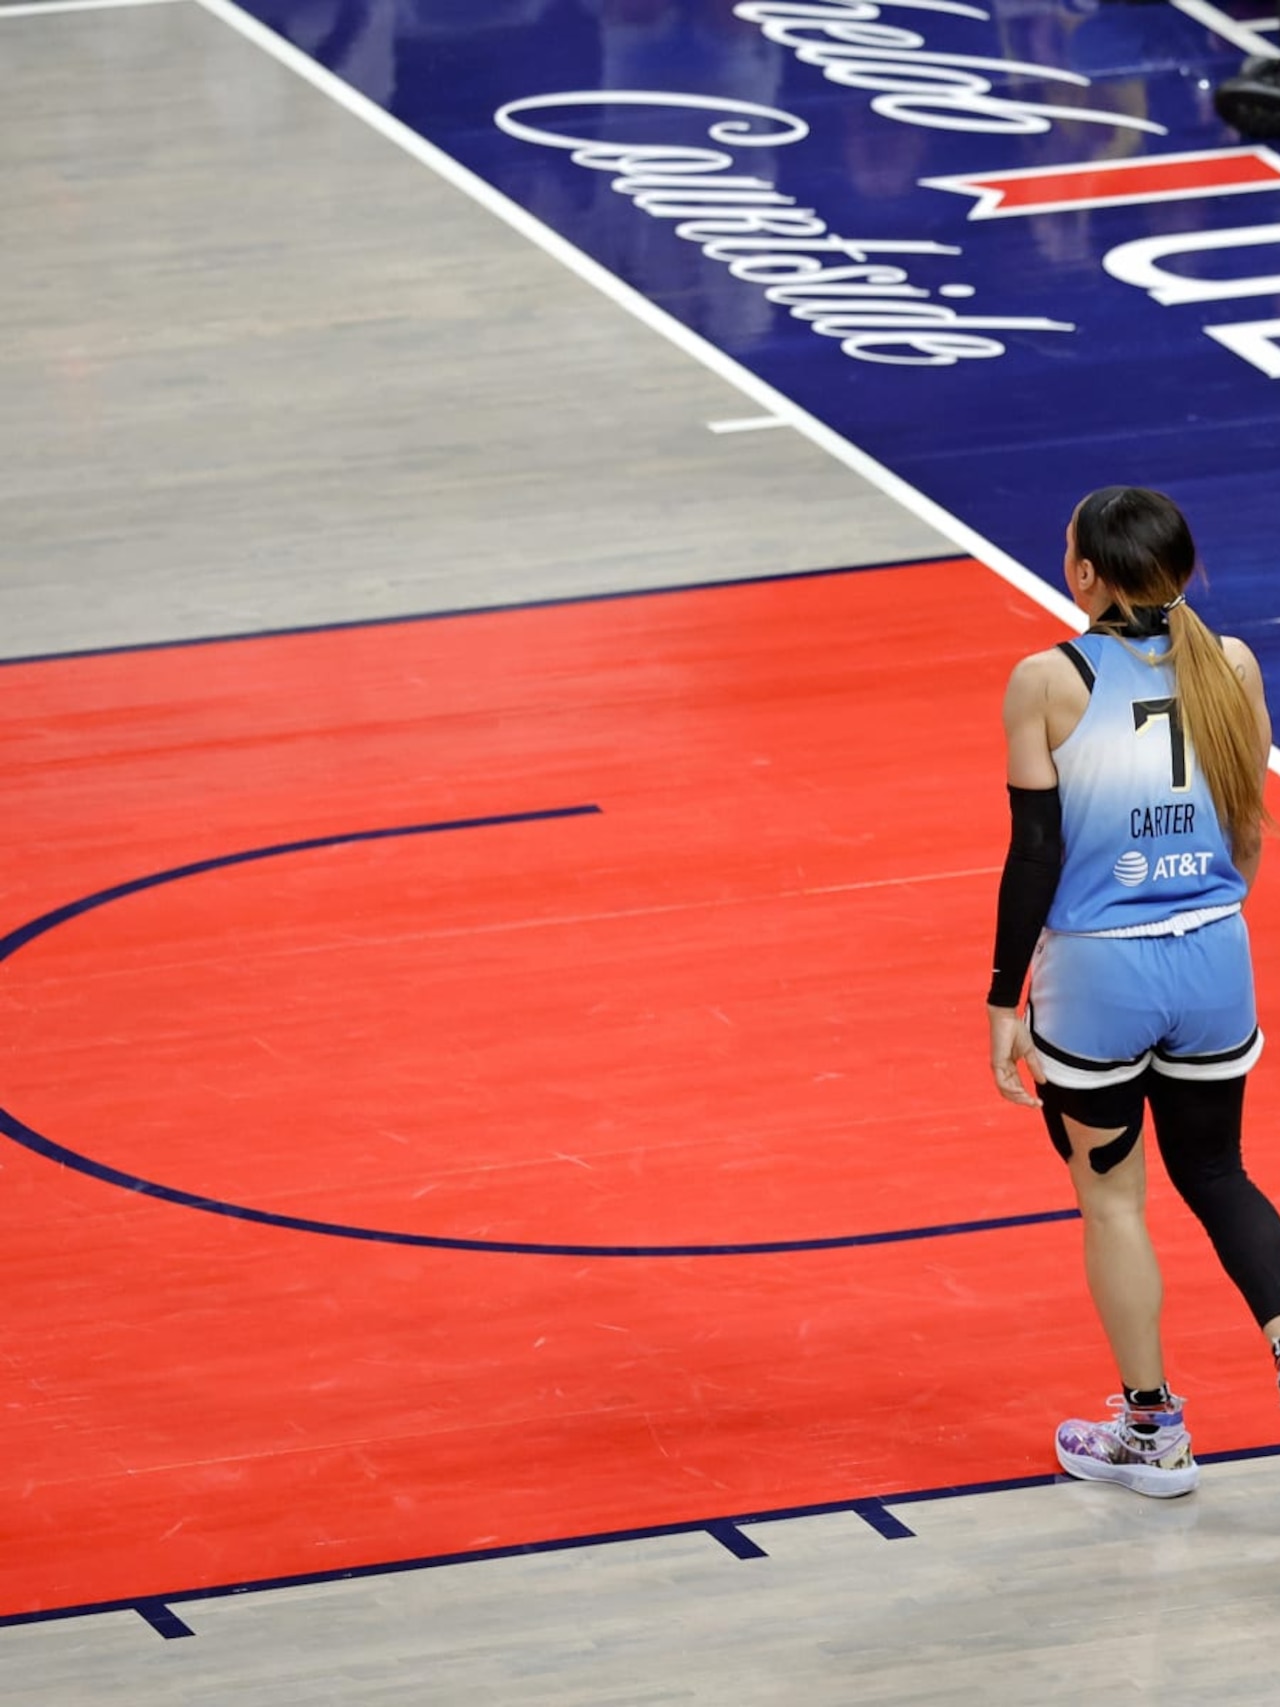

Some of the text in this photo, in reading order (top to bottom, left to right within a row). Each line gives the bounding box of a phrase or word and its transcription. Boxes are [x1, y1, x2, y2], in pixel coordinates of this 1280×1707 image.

[494, 90, 1076, 365] Courtside
[1131, 695, 1192, 793] 7
[1131, 803, 1195, 839] CARTER
[1152, 852, 1213, 880] AT&T
